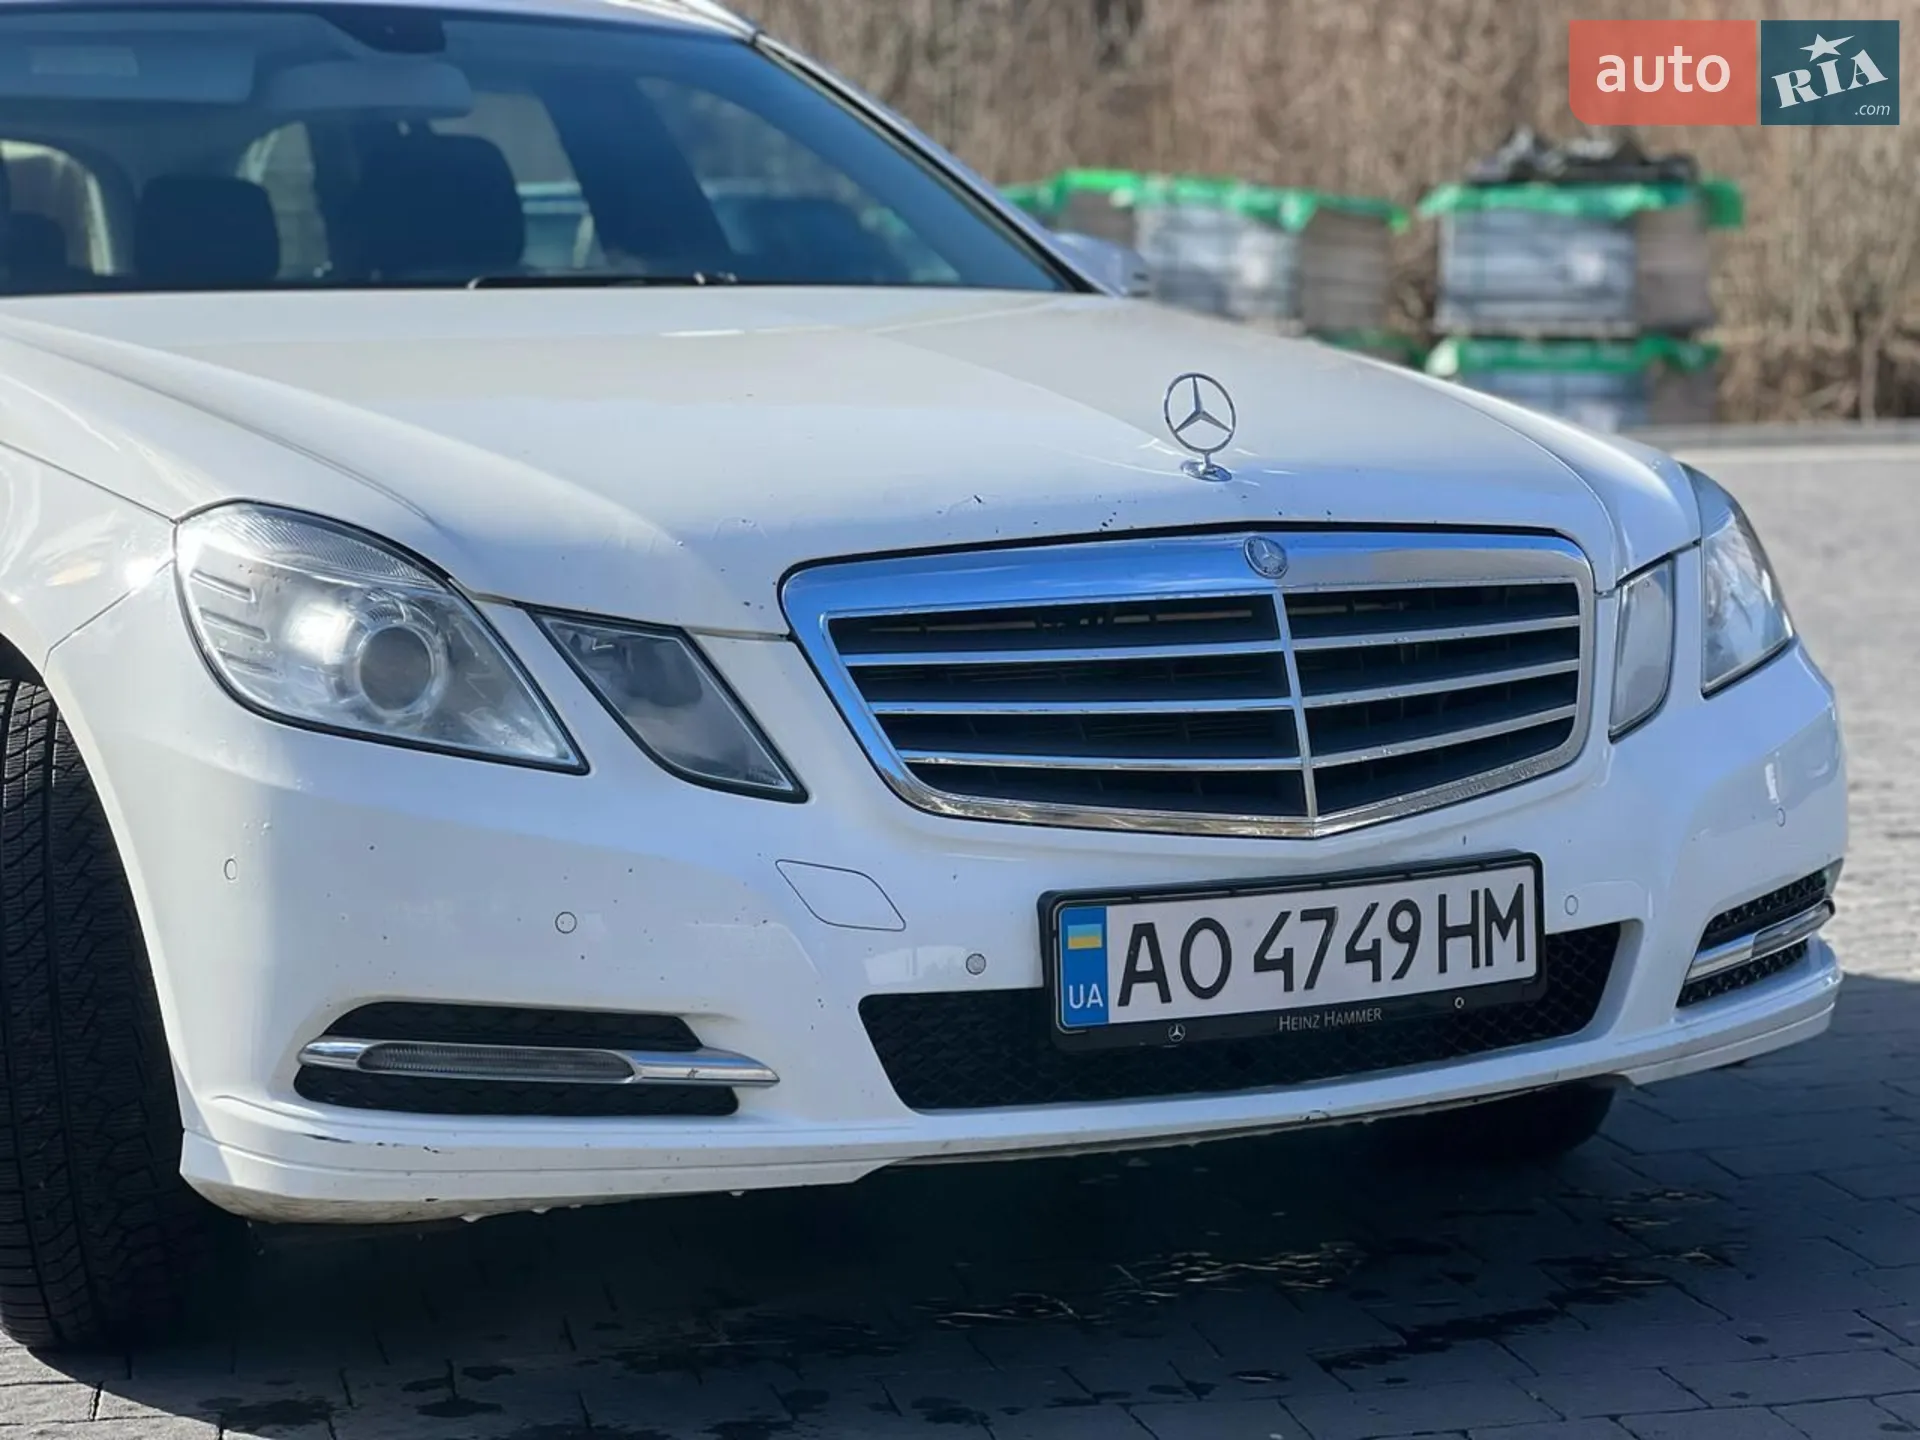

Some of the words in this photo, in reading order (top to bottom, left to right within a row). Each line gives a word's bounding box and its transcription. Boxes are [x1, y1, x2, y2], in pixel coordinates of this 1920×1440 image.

[1117, 917, 1233, 1007] AO
[1253, 898, 1422, 993] 4749
[1438, 883, 1525, 974] HM
[1068, 983, 1104, 1010] UA
